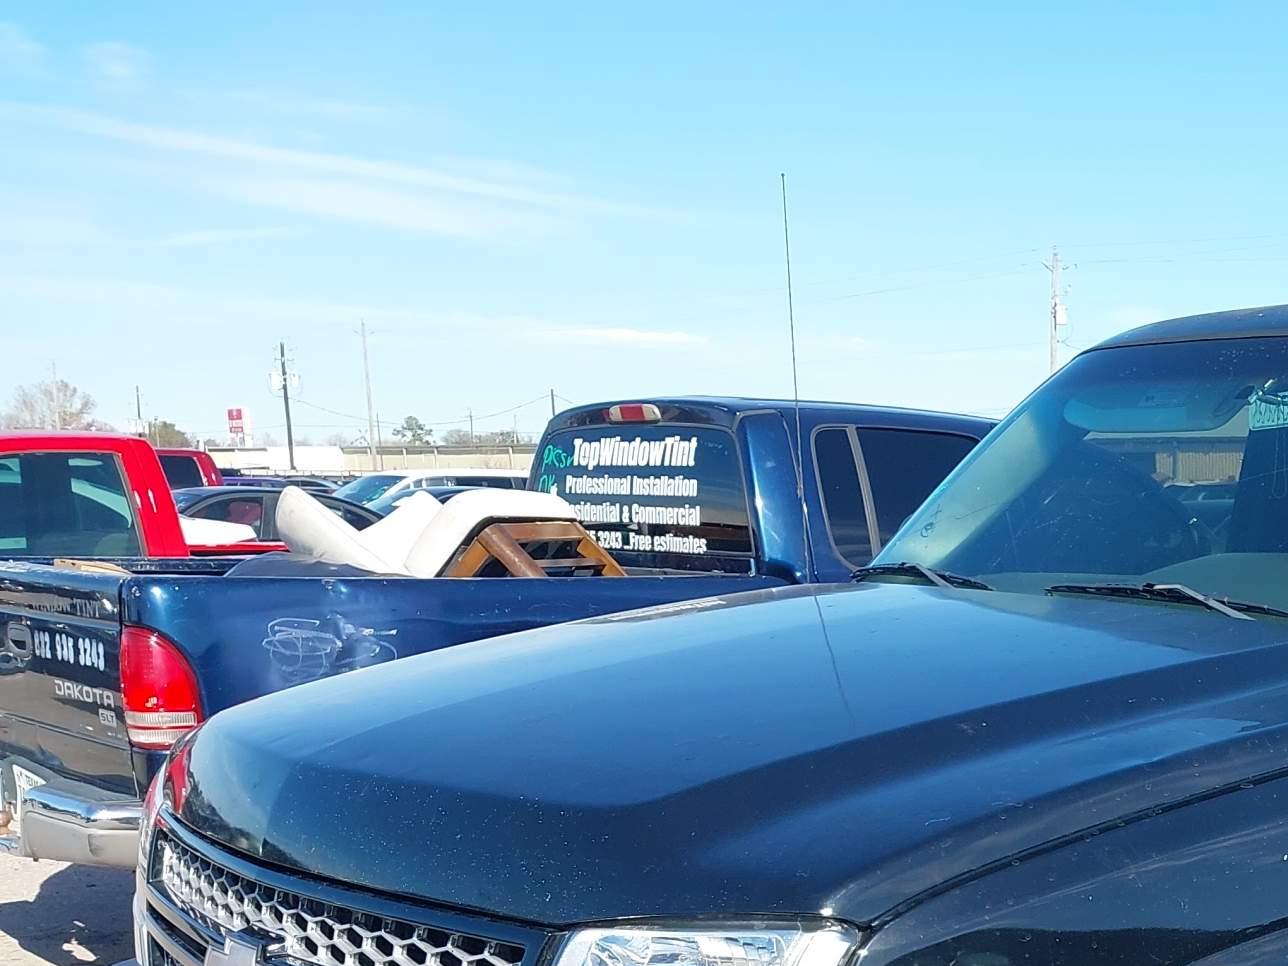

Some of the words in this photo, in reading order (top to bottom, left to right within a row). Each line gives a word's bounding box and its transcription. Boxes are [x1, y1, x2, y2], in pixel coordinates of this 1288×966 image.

[573, 435, 698, 470] TopWindowTint
[565, 474, 631, 496] Professional
[632, 475, 698, 497] Installation
[568, 501, 620, 522] esidential
[621, 504, 630, 523] &
[631, 503, 701, 526] Commercial
[597, 530, 622, 549] 3243
[653, 534, 708, 554] estimates
[54, 679, 115, 708] DAKOTA
[100, 711, 115, 724] SLT
